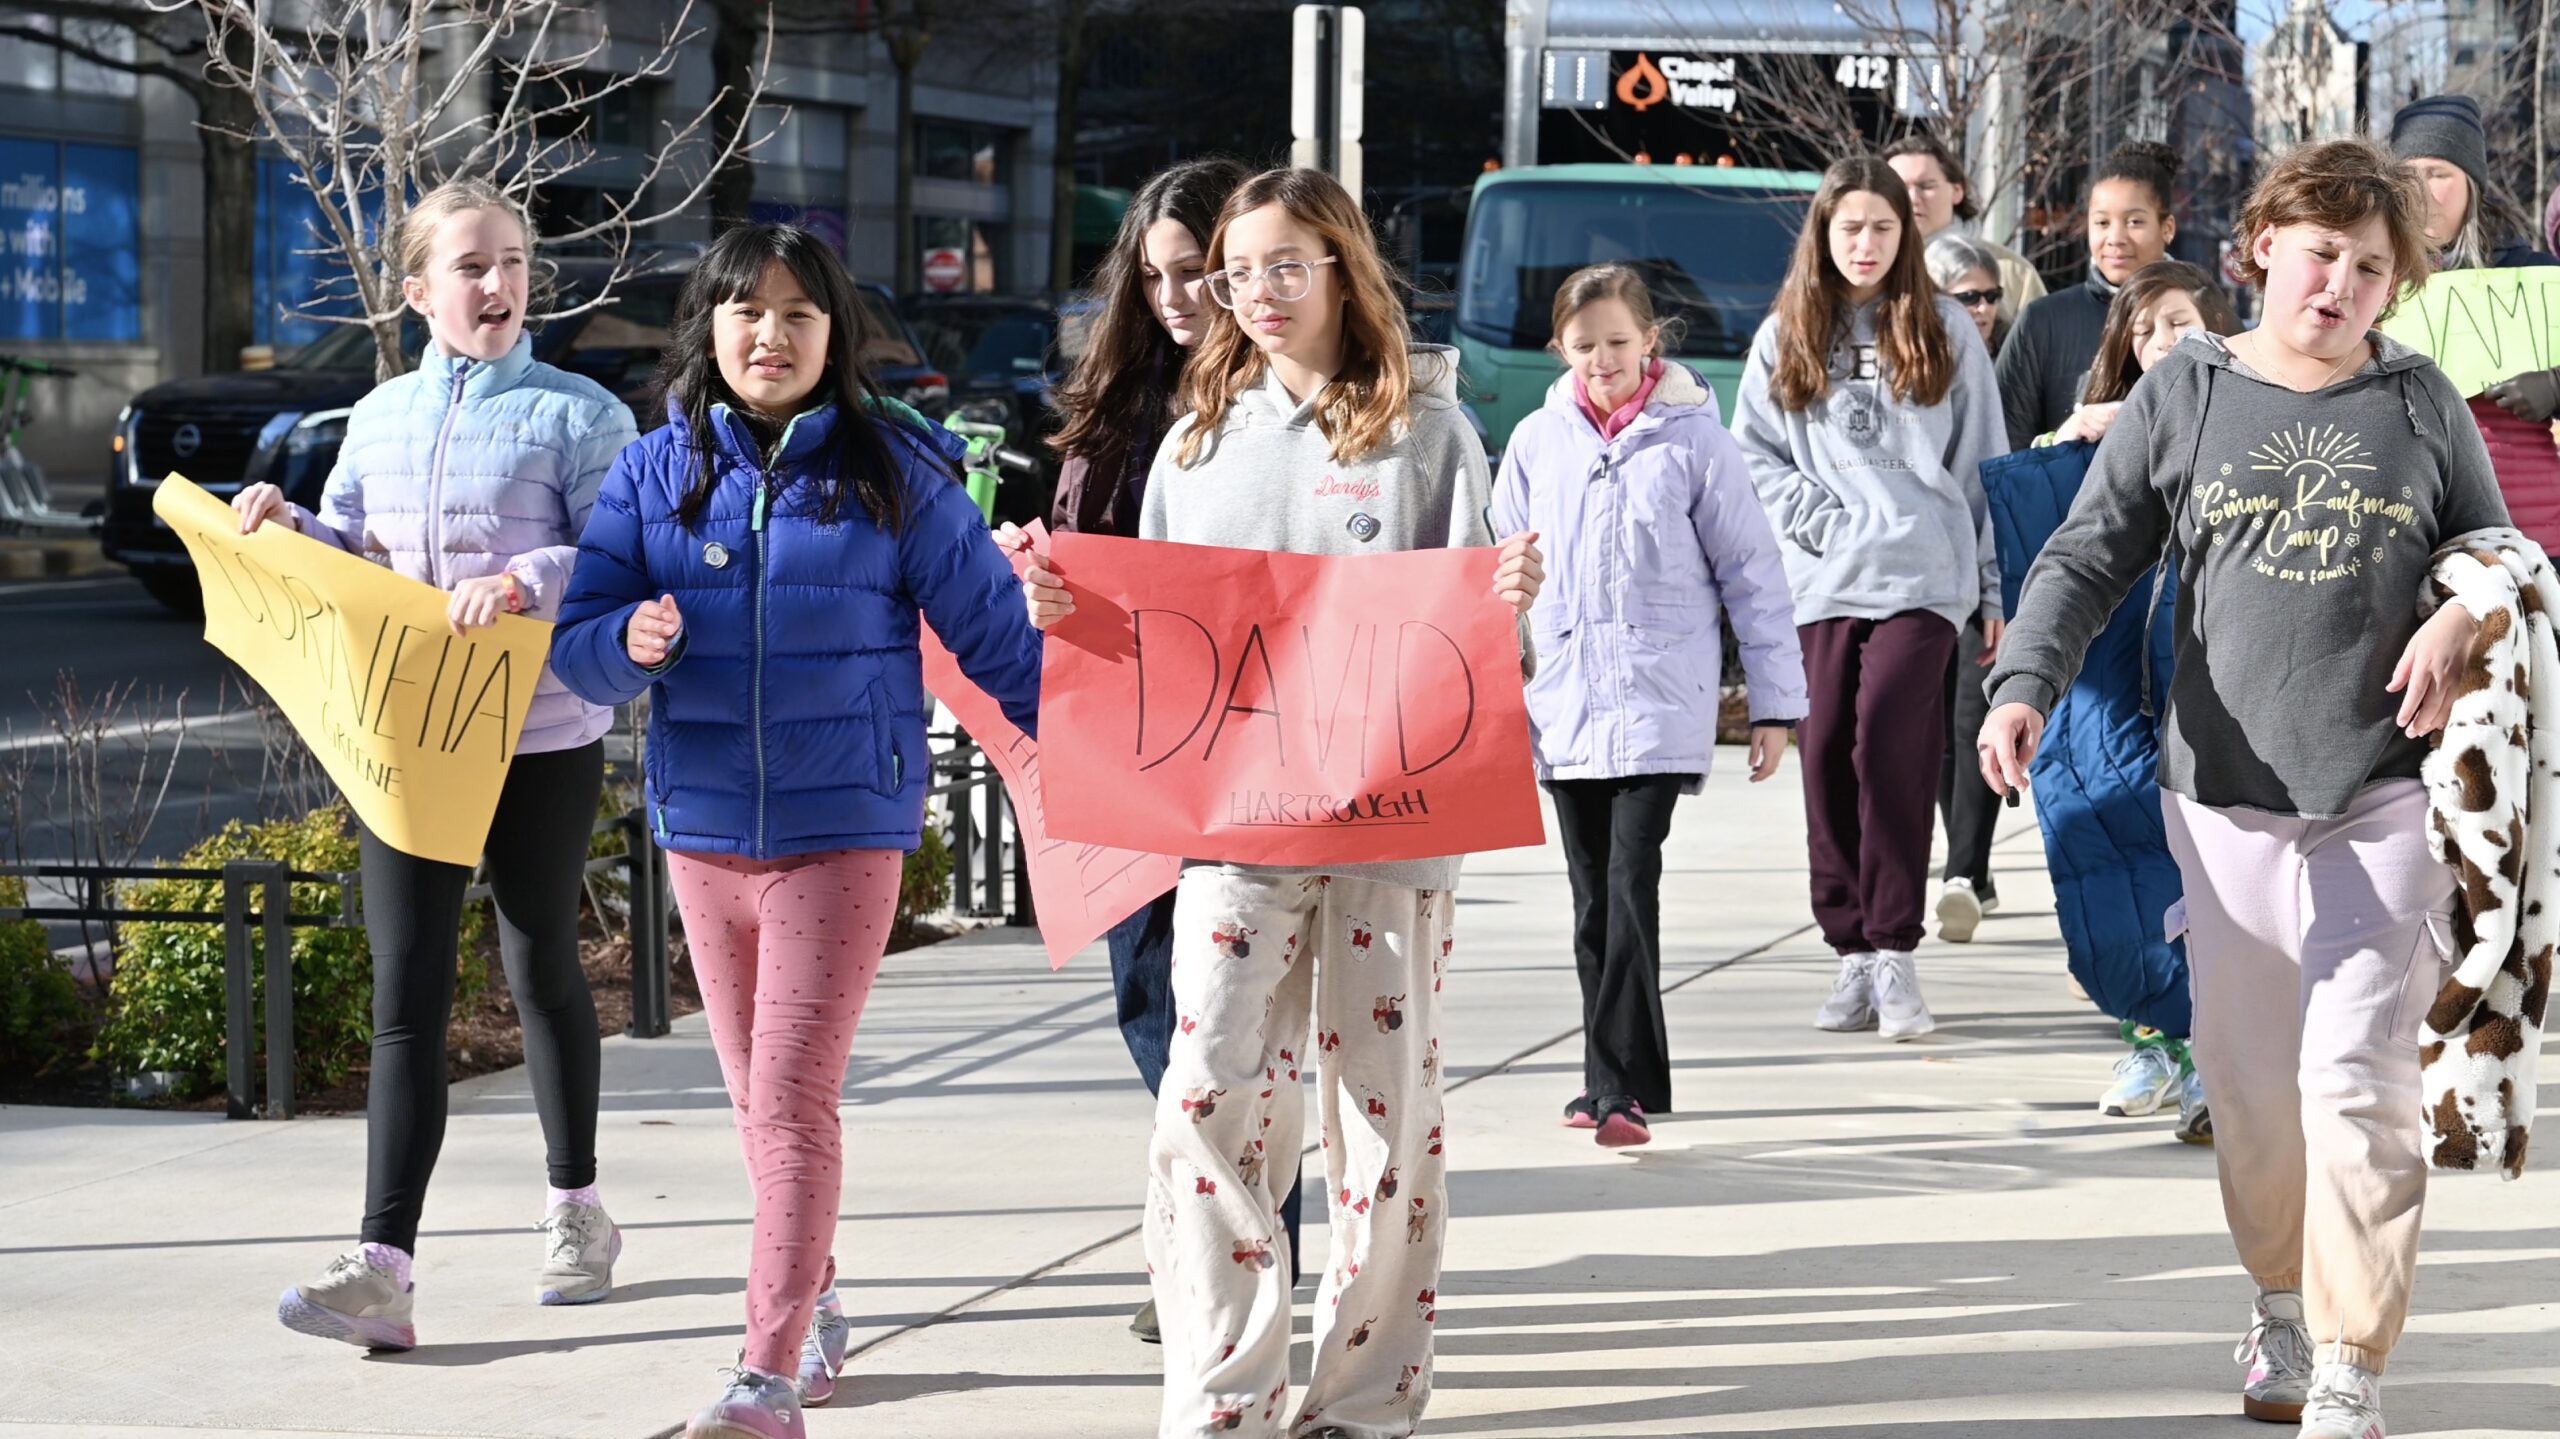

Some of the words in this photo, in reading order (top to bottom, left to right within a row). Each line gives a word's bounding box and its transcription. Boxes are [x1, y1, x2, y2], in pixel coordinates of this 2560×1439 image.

[1835, 55, 1889, 88] 412
[1668, 80, 1736, 113] Valley
[9, 218, 57, 257] with
[14, 266, 87, 304] Mobile
[1313, 474, 1380, 503] Dandy's
[2202, 481, 2279, 526] Emma
[2291, 474, 2414, 528] Kaufmann
[2266, 510, 2339, 567] Camp
[2257, 561, 2275, 577] we
[2279, 568, 2304, 581] are
[2310, 563, 2357, 586] family
[1131, 609, 1474, 778] DAVID
[1231, 788, 1429, 824] HARTSOUGH
